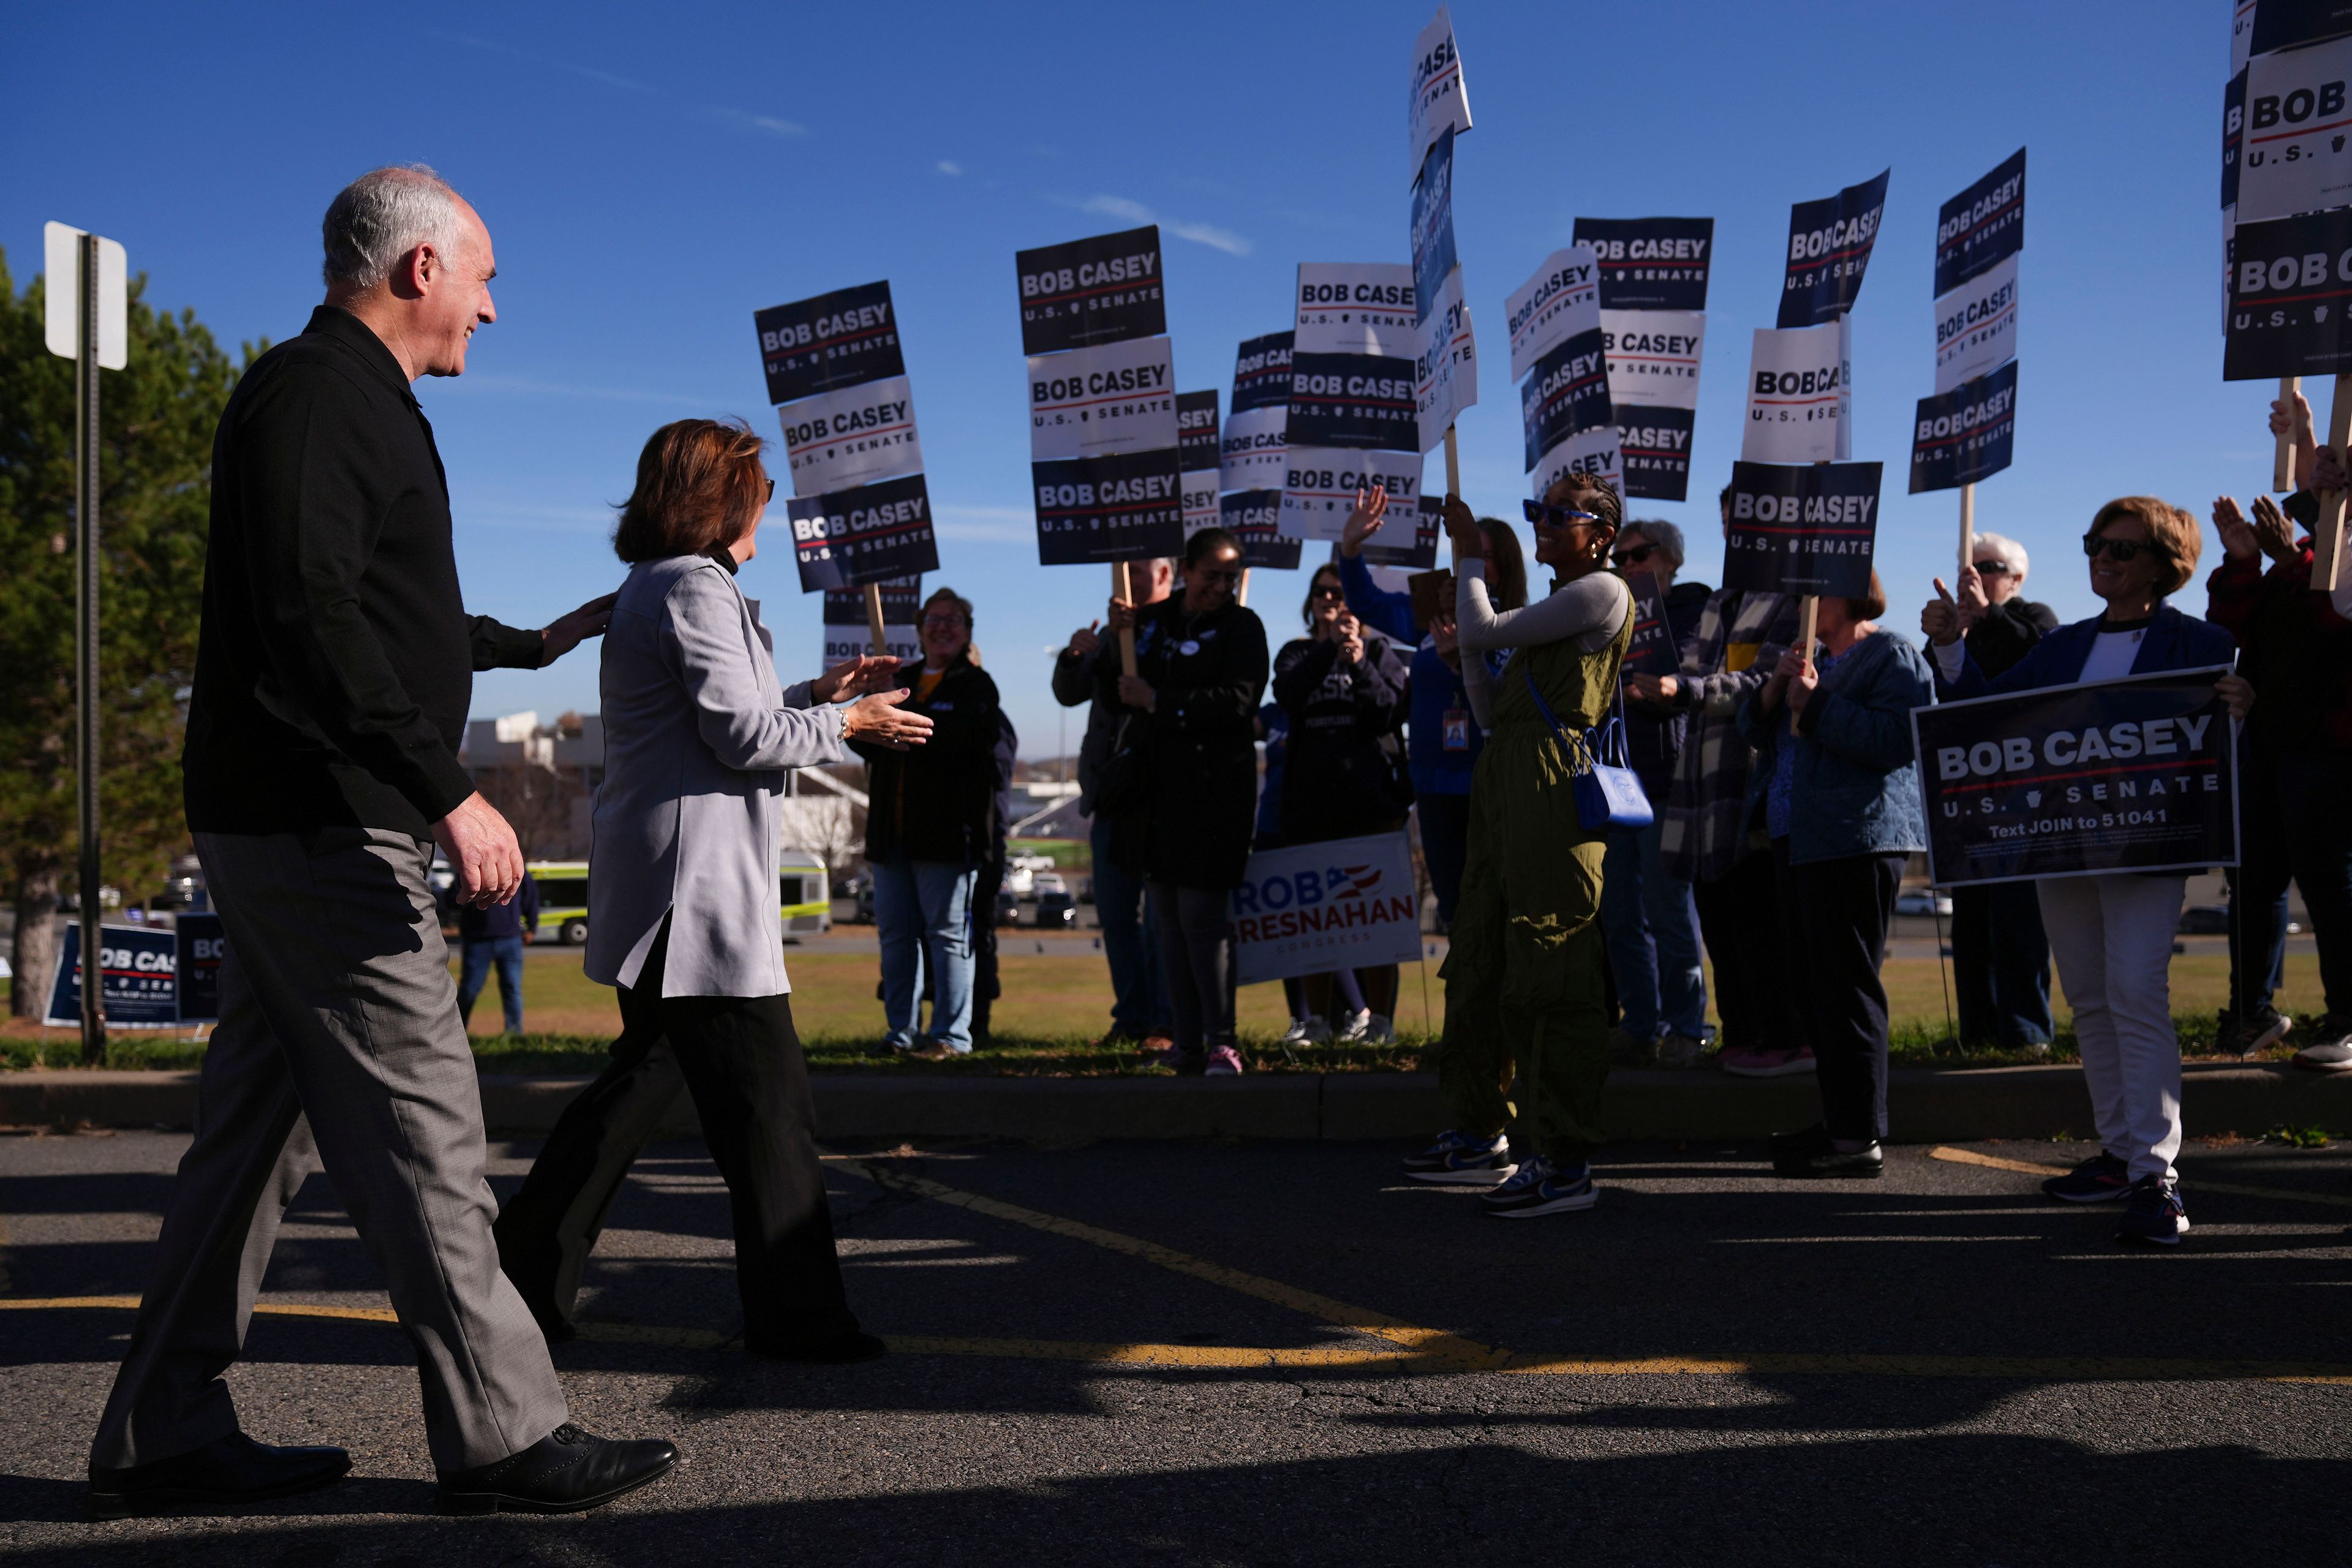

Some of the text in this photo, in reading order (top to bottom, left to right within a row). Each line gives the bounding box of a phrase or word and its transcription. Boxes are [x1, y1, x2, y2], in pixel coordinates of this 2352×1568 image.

[2252, 80, 2345, 130] BOB
[2248, 145, 2313, 168] U.S.
[1939, 172, 2022, 245] BOB CASEY
[1791, 203, 1883, 260] BOB CASEY
[1975, 206, 2022, 244] SENATE
[1630, 238, 1706, 259] CASEY
[1022, 252, 1156, 296] BOB CASEY
[1634, 270, 1704, 281] SENATE
[1787, 273, 1818, 290] U.S.
[2239, 252, 2328, 293] BOB
[1302, 284, 1414, 305] BOB CASE
[1534, 264, 1591, 309] CASEY
[1025, 288, 1160, 321] U.S. SENATE
[1539, 292, 1594, 326] SENATE
[1937, 278, 2015, 343] BOB CASEY
[763, 303, 888, 352] BOB CASEY
[1300, 314, 1417, 327] U.S. SENAT
[1971, 312, 2014, 345] SENATE
[2235, 311, 2297, 330] U.S.
[768, 334, 895, 374] U.S. SENATE
[1622, 333, 1698, 353] CASEY
[1238, 349, 1292, 374] BOB CAS
[1627, 364, 1696, 377] SENATE
[1033, 364, 1166, 402] BOB CASEY
[1294, 374, 1343, 395] BOB
[1542, 351, 1600, 398] CASEY
[1755, 371, 1815, 394] BOB
[1291, 404, 1326, 416] U.S.
[1549, 382, 1605, 417] SENATE
[786, 401, 907, 447] BOB CASEY
[1035, 400, 1171, 427] U.S. SENATE
[1178, 409, 1215, 429] SEY
[1752, 409, 1796, 421] U.S.
[1917, 386, 2013, 441] BOB CASEY
[791, 432, 914, 469] U.S. SENATE
[1182, 434, 1218, 447] NATE
[1223, 432, 1286, 453] BOB CAS
[1915, 420, 2012, 463] U.S. SENATE
[1258, 456, 1281, 464] SEN
[1622, 457, 1686, 472] ENATE
[1039, 474, 1175, 507] BOB CASEY
[1287, 470, 1333, 488] BOB
[1184, 491, 1216, 509] SEY
[1284, 499, 1317, 511] U.S.
[1734, 492, 1874, 523] BOB CASEY
[794, 497, 924, 540] BOB CASEY
[1042, 510, 1179, 532] U.S. SENATE
[1185, 518, 1218, 527] NATE
[1243, 507, 1276, 526] CAS
[799, 530, 931, 562] U.S. SENATE
[1731, 535, 1776, 552] U.S.
[1635, 627, 1663, 644] ATE
[826, 642, 916, 657] BOB CSEY
[1937, 715, 2212, 781] BOB CASEY
[1943, 774, 2219, 818] U.S. SENATE
[1990, 809, 2167, 839] Text JOIN to 51041
[1234, 870, 1324, 915] ROB
[194, 938, 224, 959] BO
[1277, 932, 1371, 954] CONGRESS
[77, 948, 133, 969] OB
[138, 979, 173, 992] SEN
